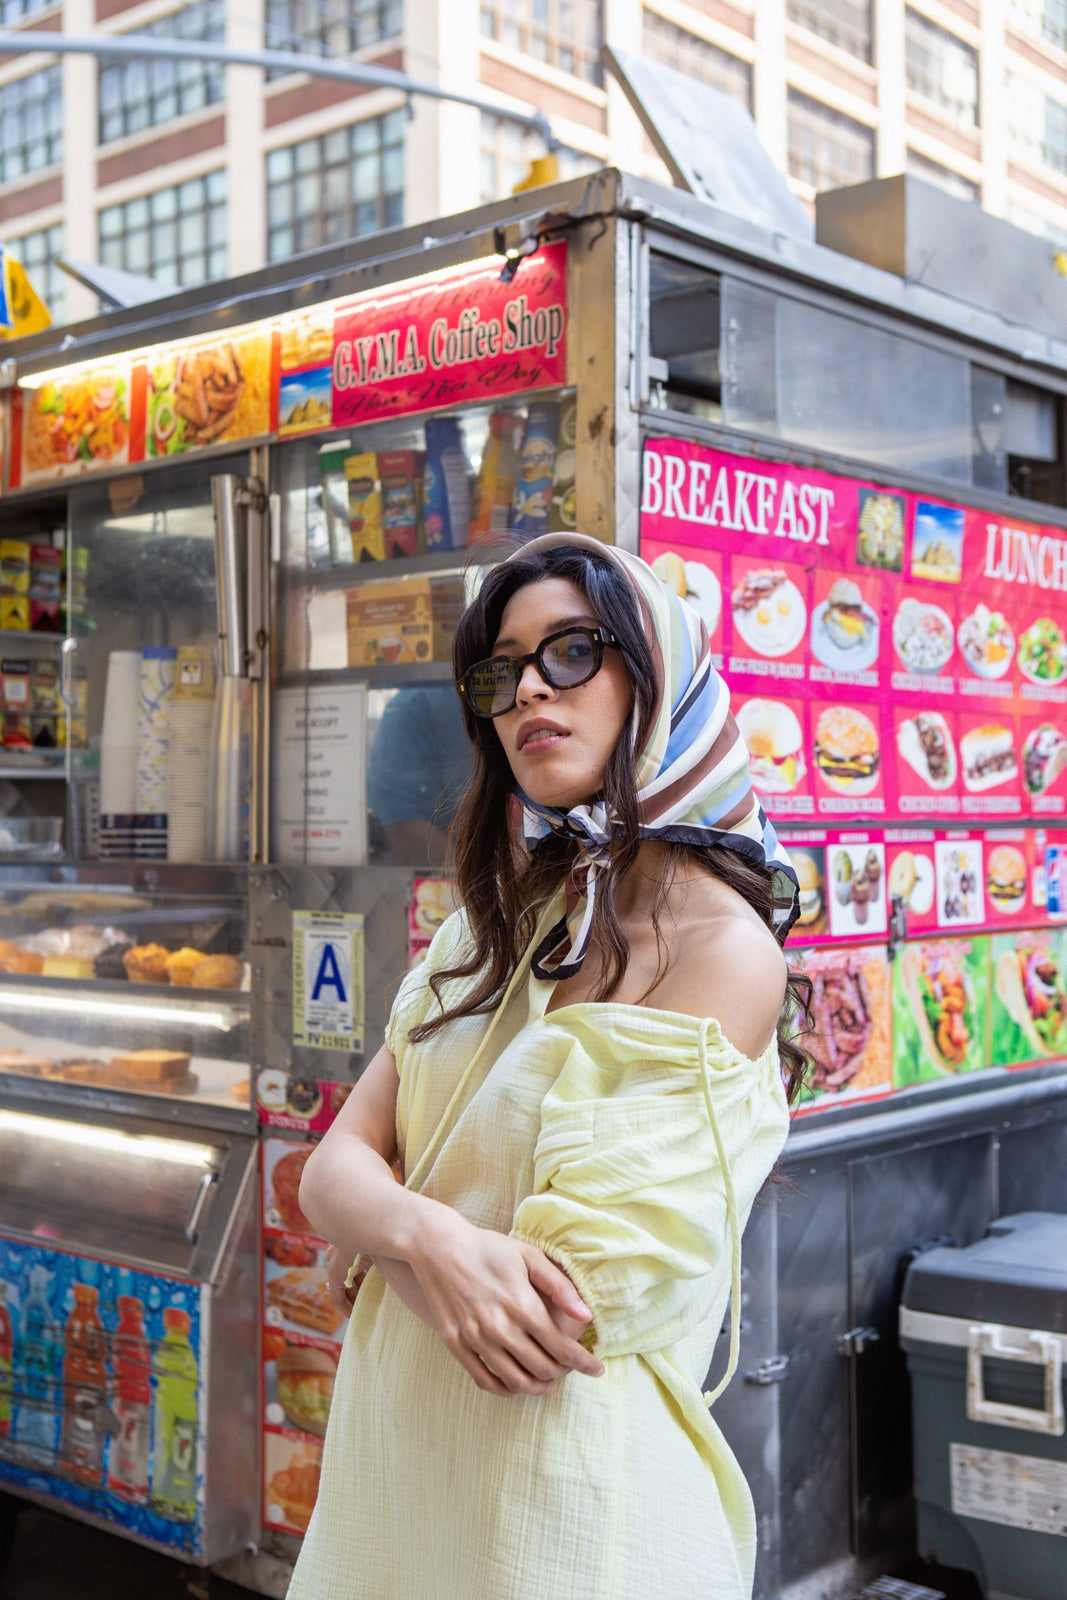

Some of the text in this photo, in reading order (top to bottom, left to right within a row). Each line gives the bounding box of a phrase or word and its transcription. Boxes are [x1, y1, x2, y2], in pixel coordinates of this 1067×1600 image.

[334, 295, 564, 391] G.Y.M.A. Coffee Shop
[477, 361, 545, 386] Day
[641, 450, 834, 546] BREAKFAST
[983, 523, 1067, 593] LUNCH
[310, 943, 348, 1003] A
